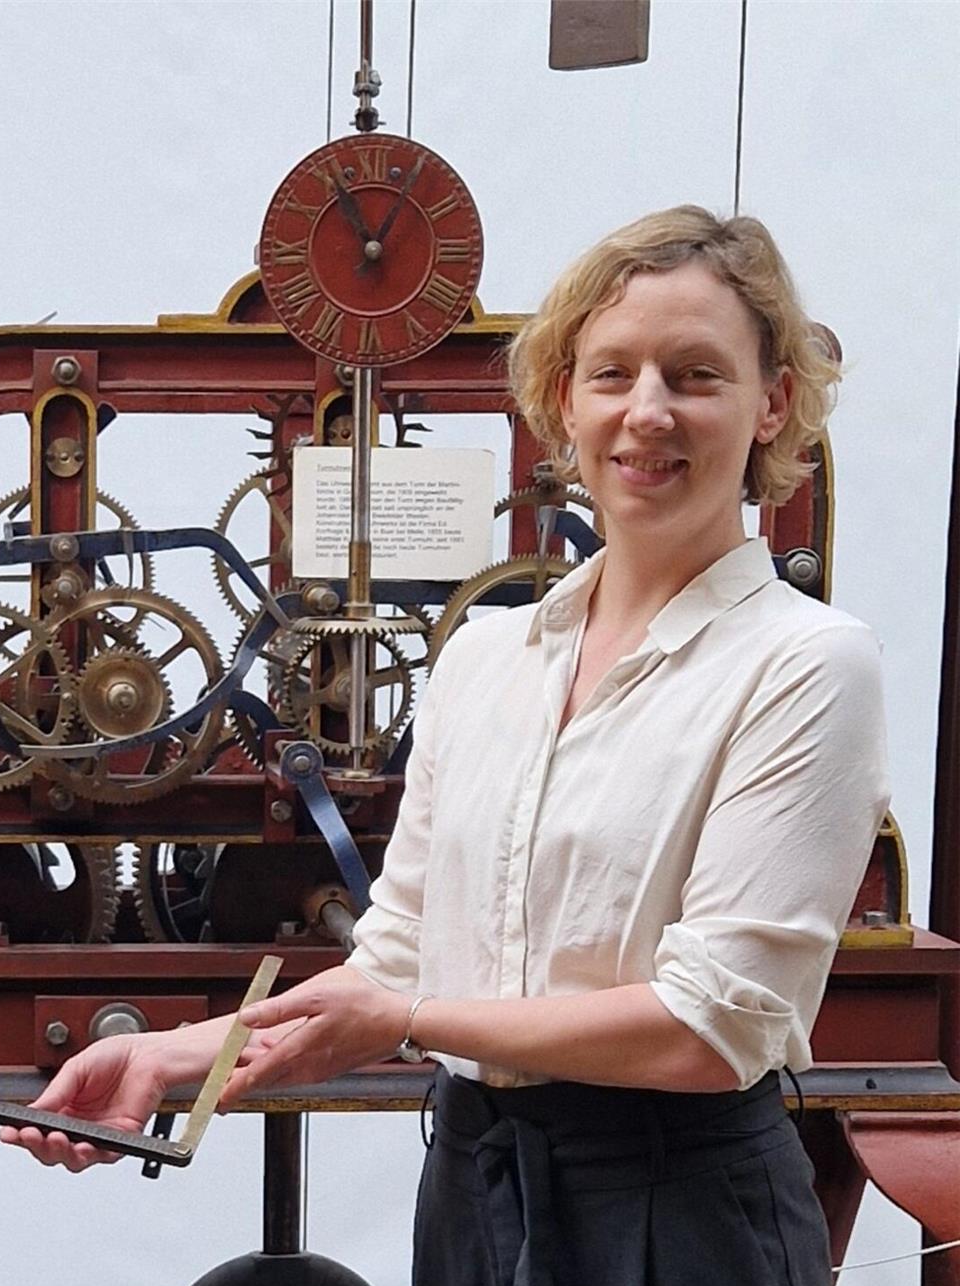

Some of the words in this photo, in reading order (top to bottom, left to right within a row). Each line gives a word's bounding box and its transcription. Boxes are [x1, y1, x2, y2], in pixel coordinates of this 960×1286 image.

[353, 145, 394, 182] XII
[426, 193, 461, 222] II
[272, 239, 308, 265] IX
[435, 238, 472, 264] III
[311, 302, 345, 347] VII
[358, 319, 384, 355] VI
[404, 310, 430, 344] V
